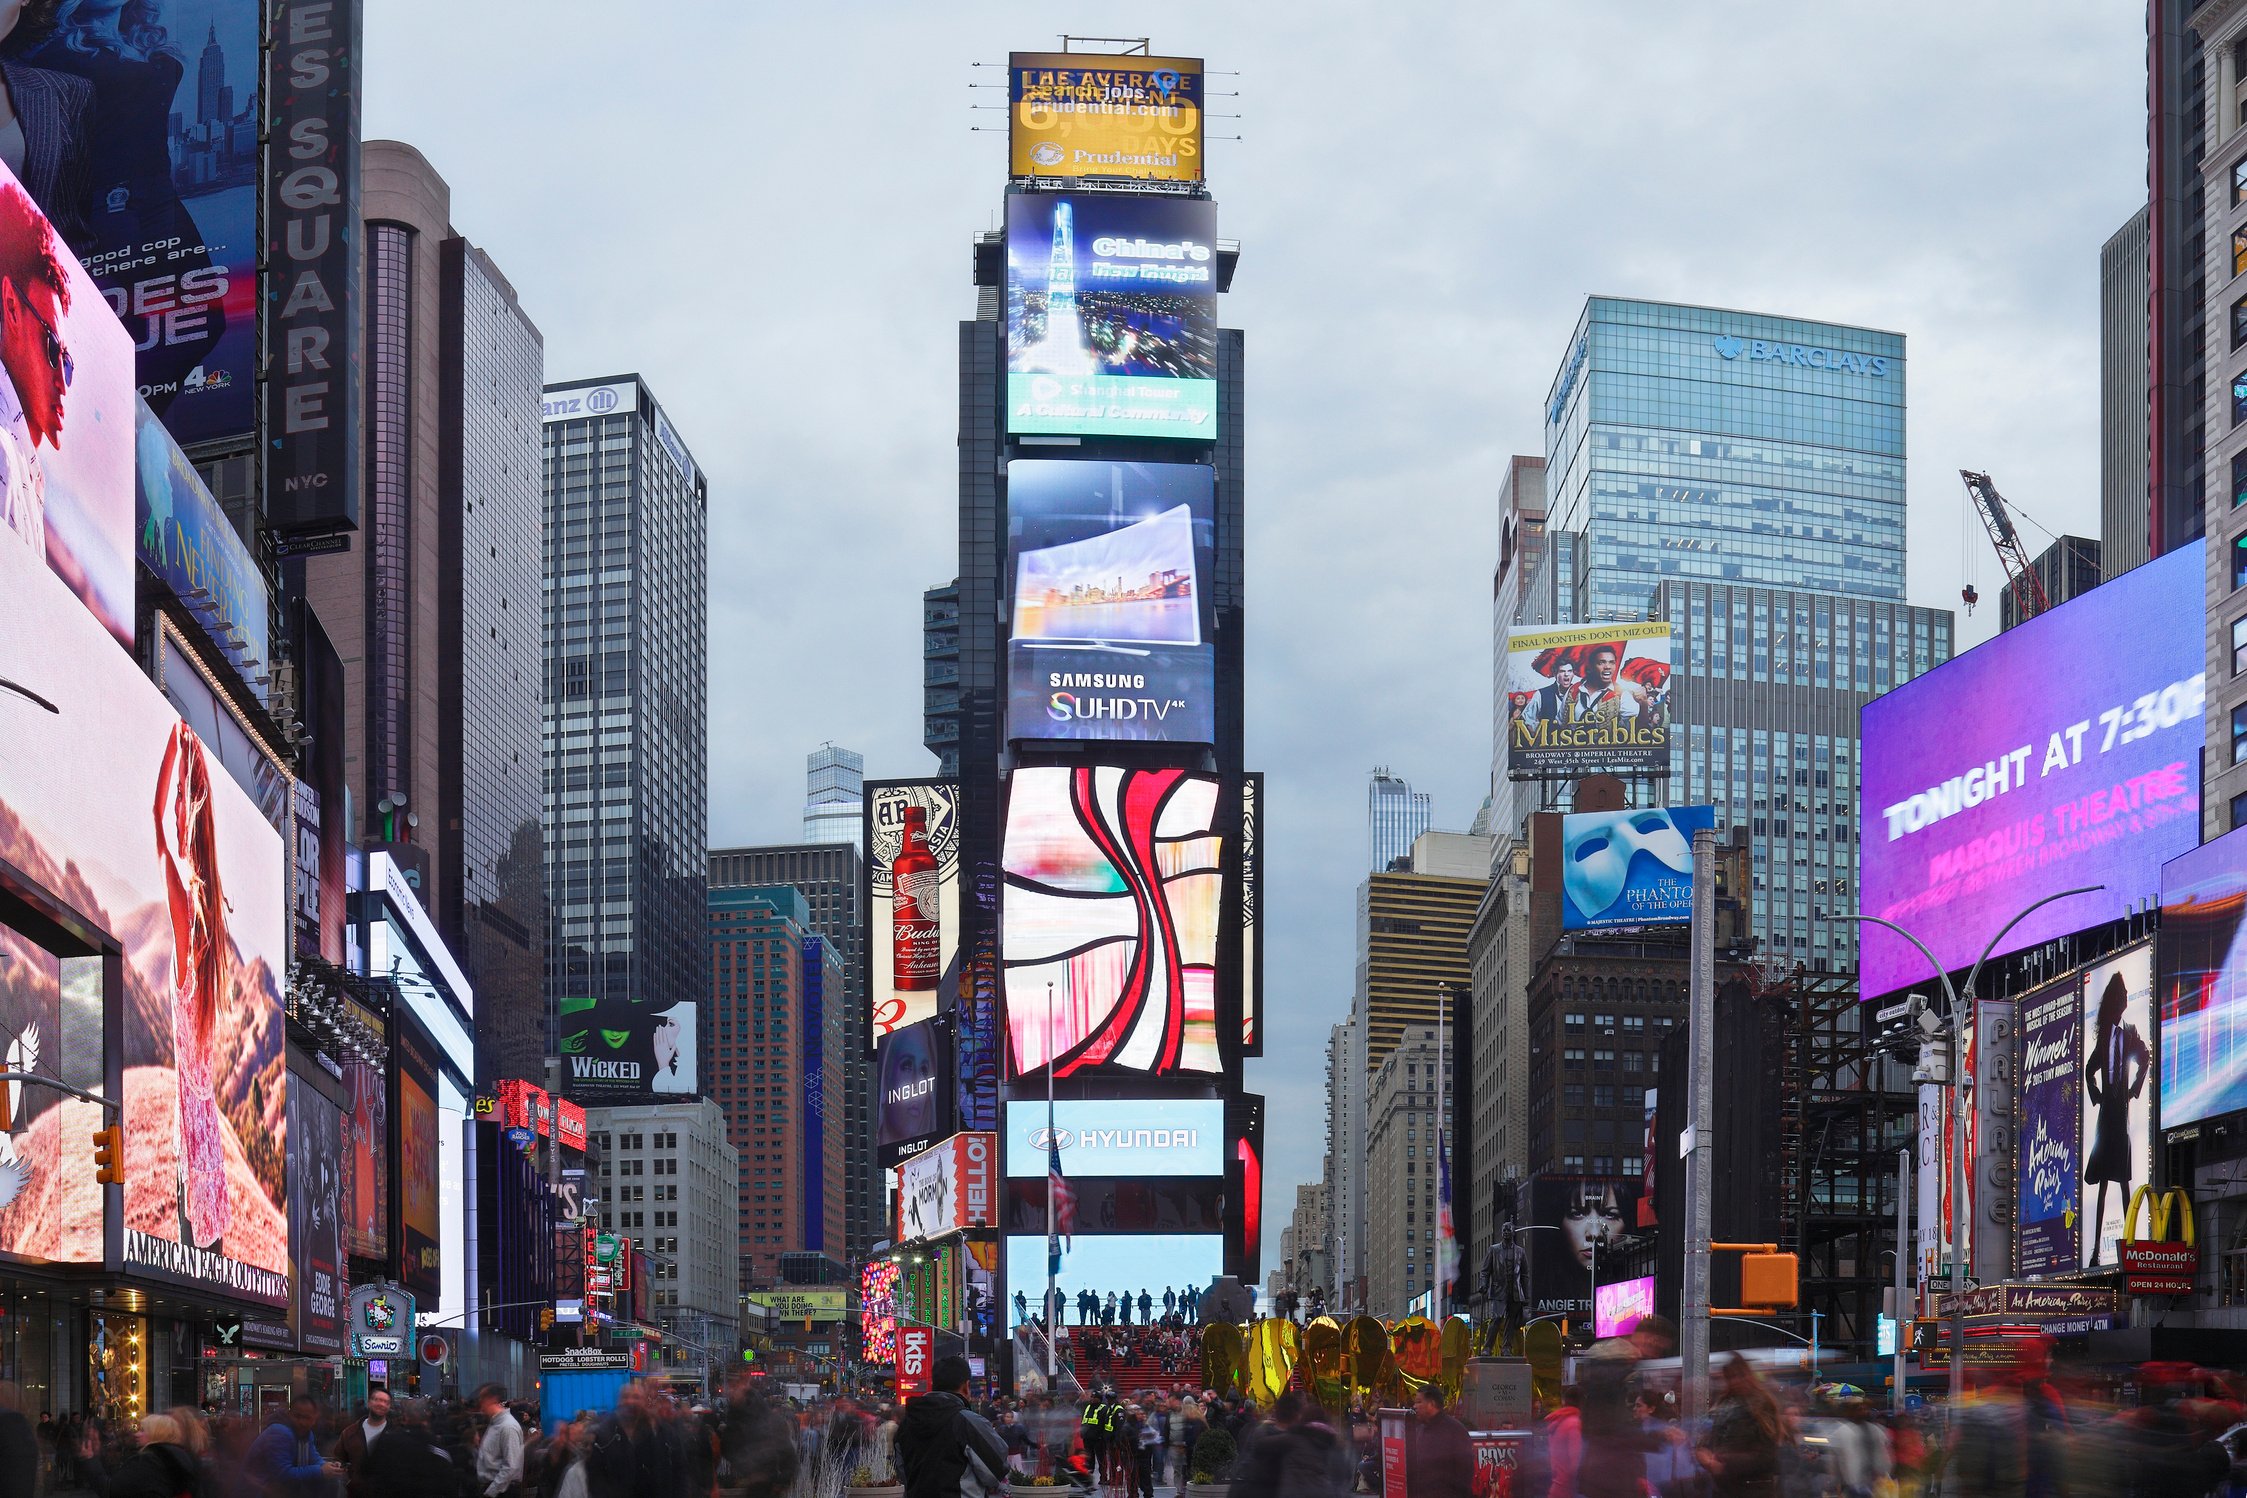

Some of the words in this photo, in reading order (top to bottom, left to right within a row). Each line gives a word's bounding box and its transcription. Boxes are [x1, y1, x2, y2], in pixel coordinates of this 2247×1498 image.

[1033, 85, 1099, 97] search
[1081, 72, 1191, 90] AVERAGE
[1032, 101, 1178, 117] prudential.com
[1126, 137, 1196, 156] DAYS
[1073, 150, 1177, 167] Prudential
[1073, 165, 1098, 174] Bring
[1102, 166, 1122, 174] Your
[80, 245, 131, 268] good
[142, 237, 181, 252] cop
[1093, 238, 1210, 261] China's
[93, 255, 156, 277] there
[167, 244, 226, 260] are...
[279, 117, 340, 433] SQUARE
[1750, 340, 1888, 376] BARCLAYS
[184, 366, 207, 387] 4
[184, 386, 204, 395] NEW
[206, 382, 230, 390] YORK
[1139, 386, 1180, 399] Tower
[543, 399, 581, 416] anz
[1017, 404, 1034, 416] A
[1036, 404, 1106, 418] Cultural
[1109, 404, 1208, 425] Community
[286, 473, 328, 492] NYC
[201, 527, 248, 620] FINDING
[1512, 638, 1540, 648] FINAL
[1590, 630, 1620, 640] DON'T
[1623, 628, 1640, 636] MIZ
[1643, 626, 1667, 635] OUT!
[1050, 673, 1144, 688] SAMSUNG
[1568, 704, 1606, 724] Les
[1514, 716, 1665, 748] Misérables
[1882, 744, 2032, 842] TONIGHT
[2041, 720, 2090, 778] AT
[1929, 814, 2044, 886] MARQUIS
[2053, 762, 2188, 836] THEATRE
[928, 826, 950, 852] ASIA
[2040, 821, 2124, 866] BROADWAY
[1658, 878, 1677, 886] THE
[1632, 903, 1647, 911] OF
[807, 959, 821, 1057] NOVOTEL
[1880, 1011, 1888, 1019] city
[2032, 1005, 2042, 1019] MOST
[2026, 1018, 2042, 1032] MUSICAL
[2043, 1014, 2048, 1025] OF
[2024, 1022, 2074, 1071] Winner!
[2025, 1072, 2032, 1094] 4
[2033, 1072, 2042, 1086] 2015
[2043, 1067, 2054, 1082] TONY
[2055, 1061, 2074, 1078] AWARDS
[888, 1077, 936, 1104] INGLOT
[1922, 1103, 1929, 1130] R
[1988, 1018, 2010, 1224] PALACE
[1080, 1129, 1197, 1148] HYUNDAI
[2036, 1114, 2047, 1147] An
[899, 1140, 928, 1156] INGLOT
[2028, 1138, 2070, 1178] American
[968, 1137, 986, 1224] HELLO!
[2034, 1165, 2061, 1199] Paris
[1929, 1228, 1936, 1241] 18
[128, 1230, 197, 1278] AMERICAN
[201, 1251, 233, 1284] EAGLE
[236, 1262, 288, 1301] OUTFITTERS
[2126, 1250, 2196, 1262] McDonald's
[315, 1272, 330, 1296] EDDIE
[311, 1292, 335, 1318] GEORGE
[791, 1302, 814, 1310] DOING
[1537, 1300, 1574, 1311] ANGIE
[1579, 1300, 1591, 1310] TR
[2011, 1293, 2023, 1307] An
[2026, 1291, 2068, 1311] American
[2070, 1292, 2092, 1310] Paris
[792, 1309, 816, 1317] THERE?
[2041, 1323, 2065, 1334] CHANGE
[2067, 1321, 2090, 1332] MONEY
[2094, 1319, 2108, 1330] ATM
[565, 1347, 602, 1355] SnackBox
[905, 1331, 926, 1375] tkts
